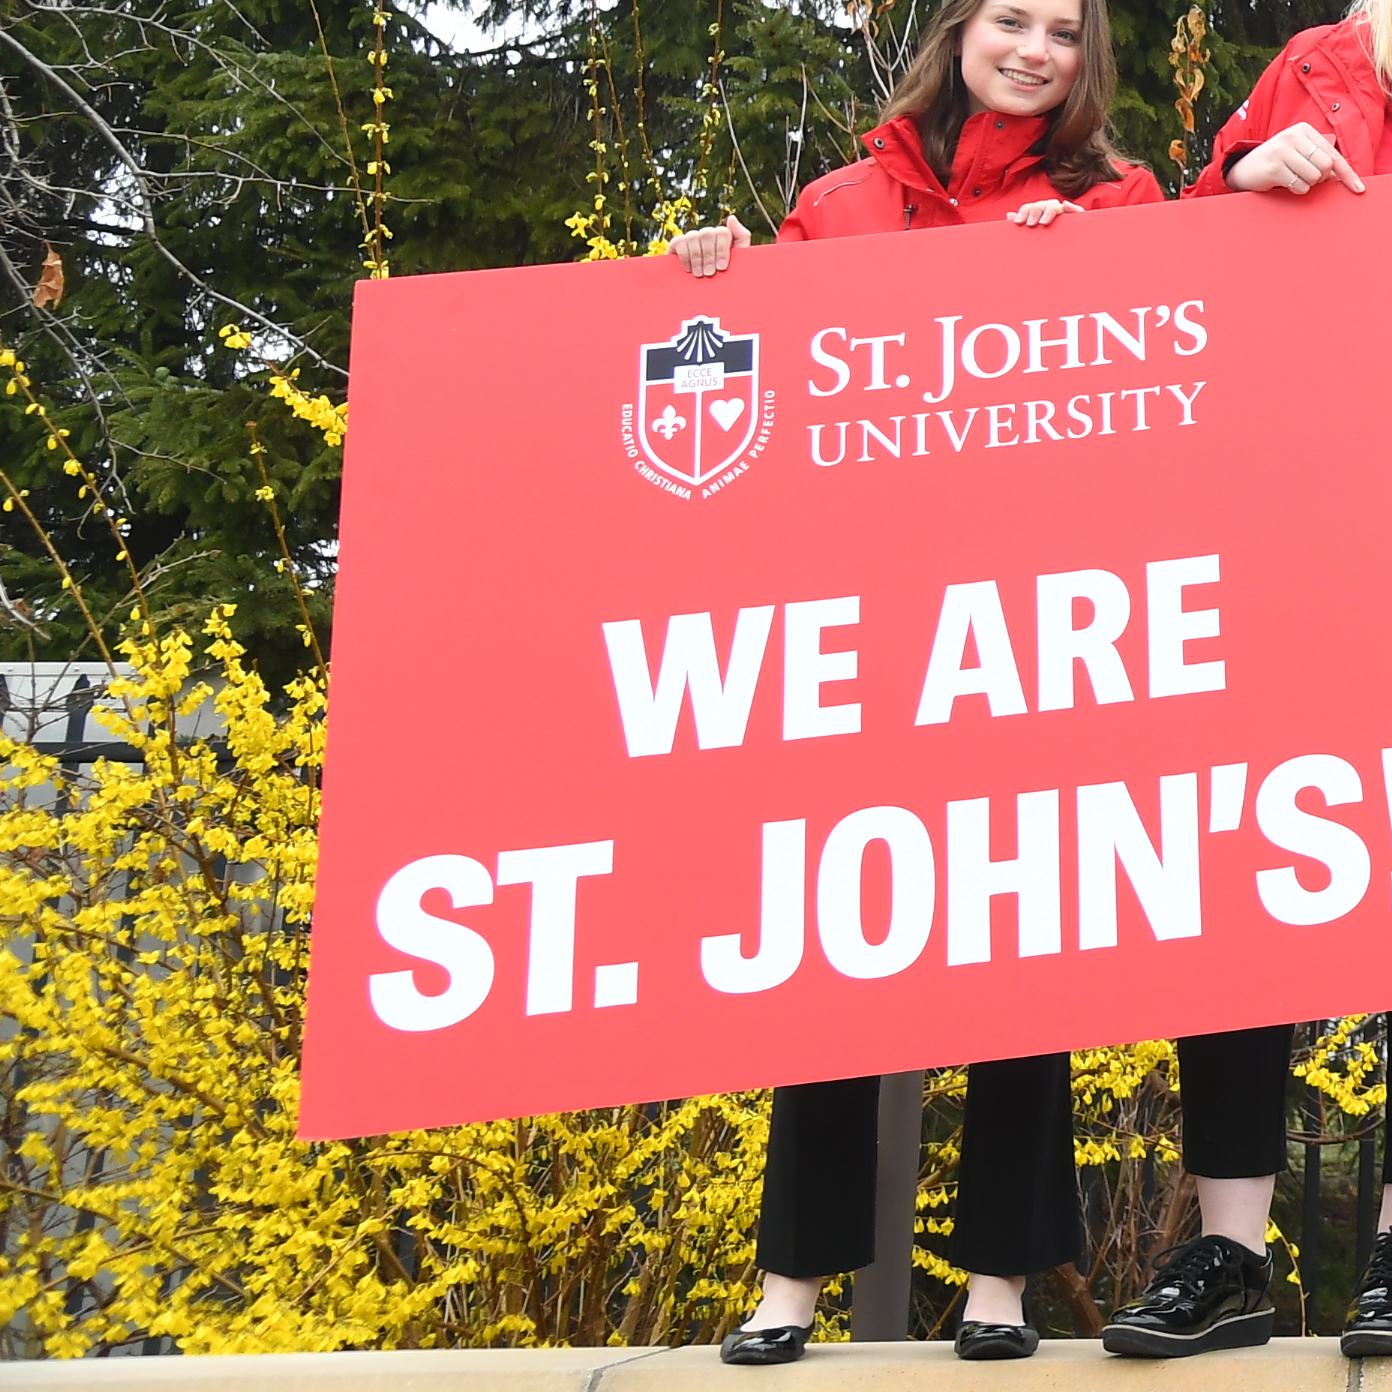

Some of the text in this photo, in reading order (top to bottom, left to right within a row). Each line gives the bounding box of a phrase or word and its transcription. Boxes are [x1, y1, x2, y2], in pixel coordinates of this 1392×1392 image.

[681, 377, 718, 389] AGNUS
[687, 367, 713, 379] ECCE
[807, 299, 1208, 404] ST. JOHN'S
[621, 389, 776, 501] EDUCATIO CHRISTIANA ANIMAE PERFECTIO
[806, 381, 1207, 467] UNIVERSITY
[602, 553, 1227, 759] WE ARE
[369, 839, 639, 1032] ST.
